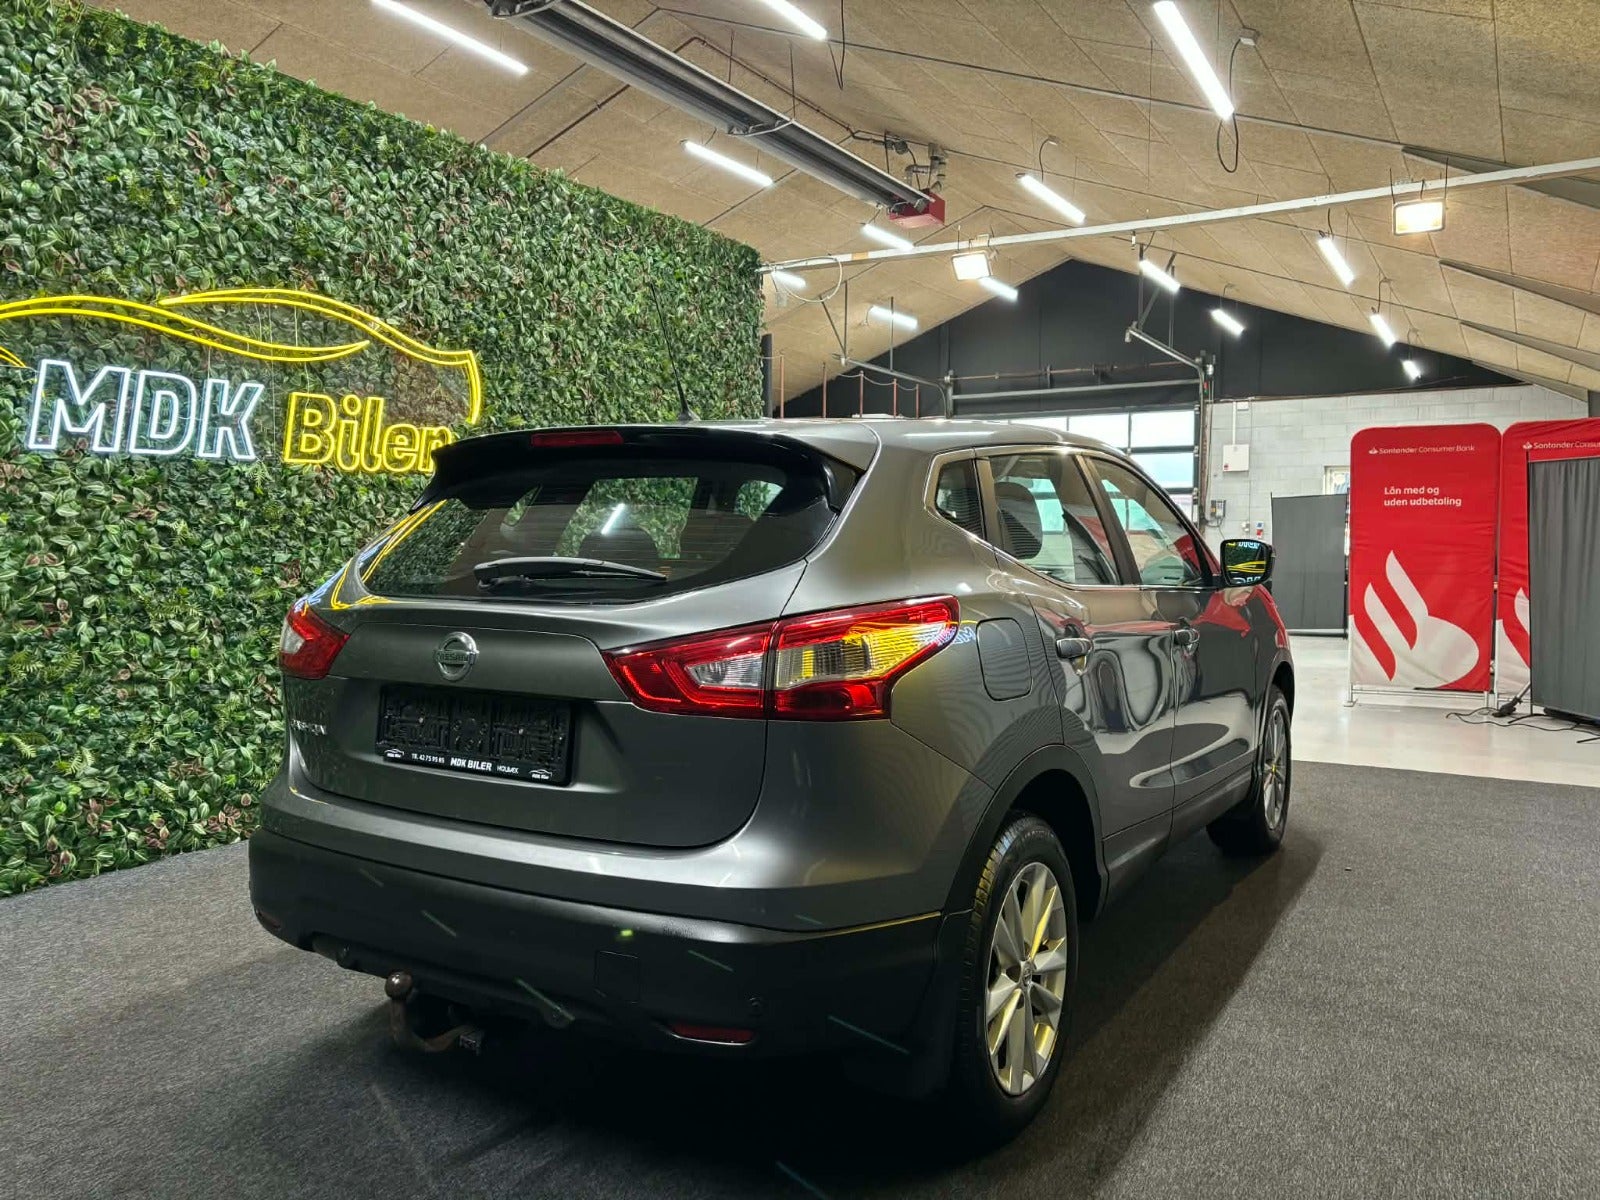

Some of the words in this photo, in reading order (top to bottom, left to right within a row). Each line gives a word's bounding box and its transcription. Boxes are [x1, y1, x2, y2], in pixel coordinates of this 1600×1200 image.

[27, 357, 265, 462] MDK
[283, 391, 452, 473] Biler
[1378, 446, 1417, 455] Santander
[1418, 445, 1454, 454] Consumer
[1456, 443, 1475, 452] Bank
[1533, 441, 1573, 450] Santander
[1384, 485, 1402, 495] Lån
[1404, 485, 1425, 495] med
[1427, 487, 1439, 496] og
[1384, 497, 1408, 507] uden
[1410, 496, 1462, 508] udbetaling
[450, 757, 466, 768] MDK
[467, 759, 492, 771] BILER
